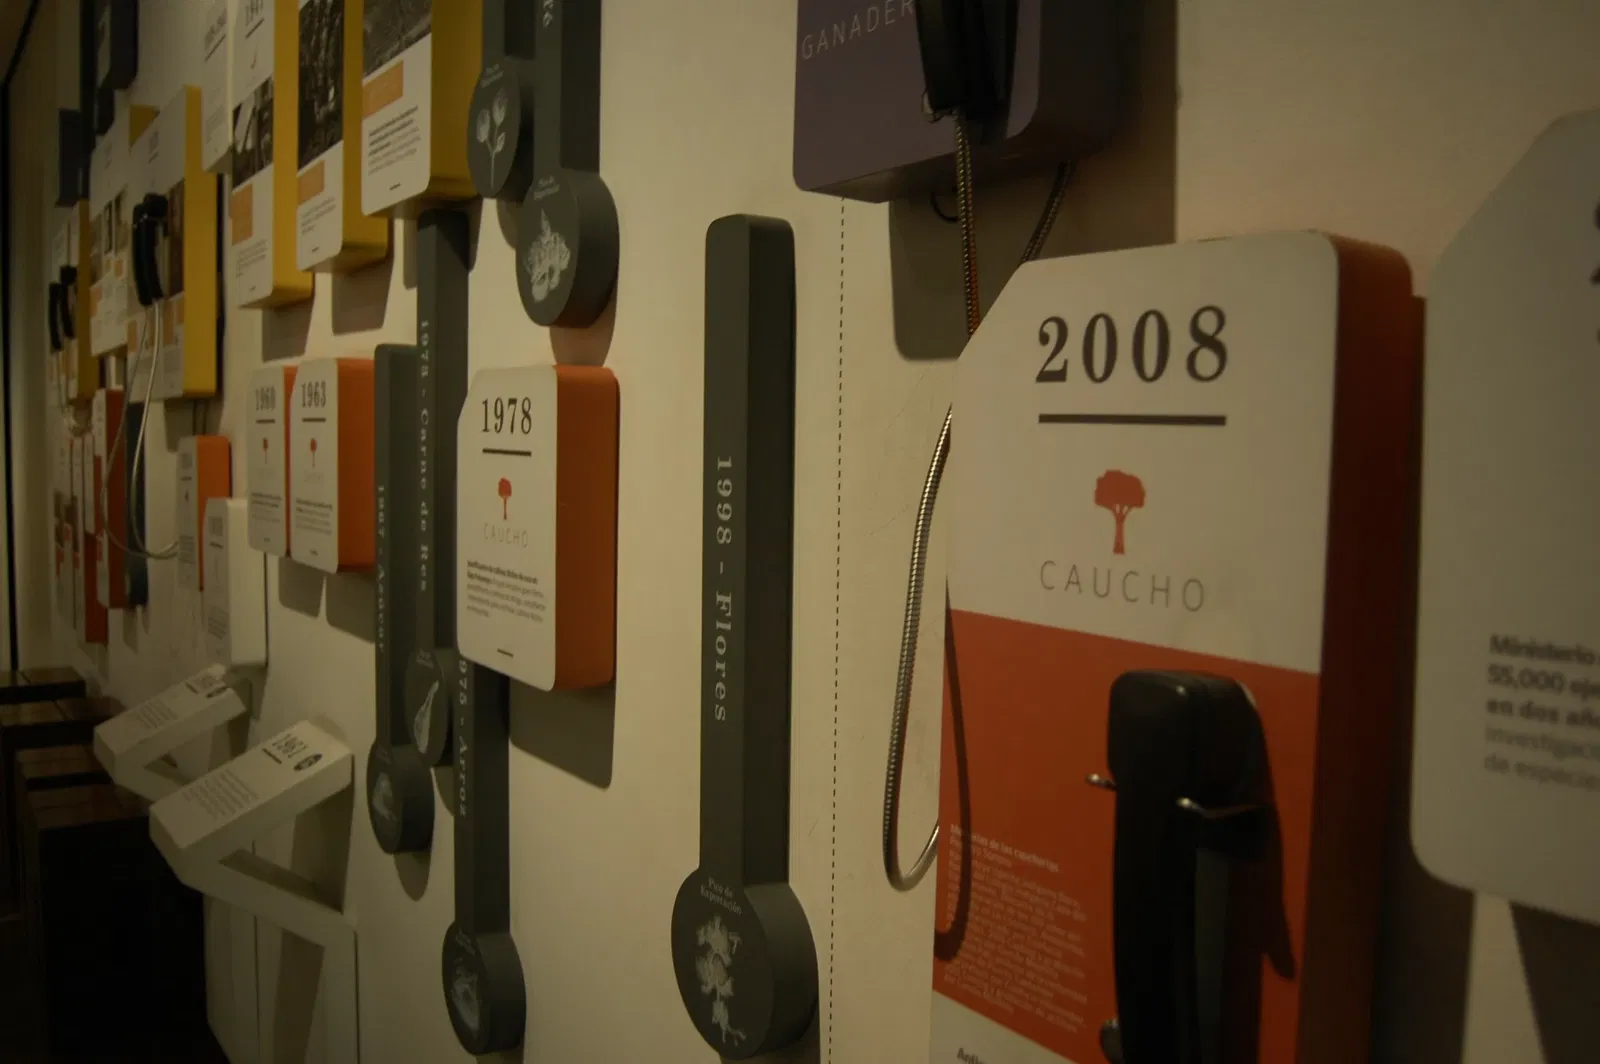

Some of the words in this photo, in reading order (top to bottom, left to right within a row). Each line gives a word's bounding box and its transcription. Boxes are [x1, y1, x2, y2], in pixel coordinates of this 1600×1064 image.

[801, 0, 914, 59] GANADER
[1035, 305, 1227, 383] 2008
[482, 396, 532, 435] 1978
[420, 408, 429, 489] Carne
[420, 501, 429, 532] de
[716, 455, 733, 544] 1998
[483, 521, 529, 548] CAUCHO
[420, 544, 429, 592] Res
[1039, 560, 1205, 612] CAUCHO
[459, 659, 468, 705] 975
[714, 591, 732, 722] Flores
